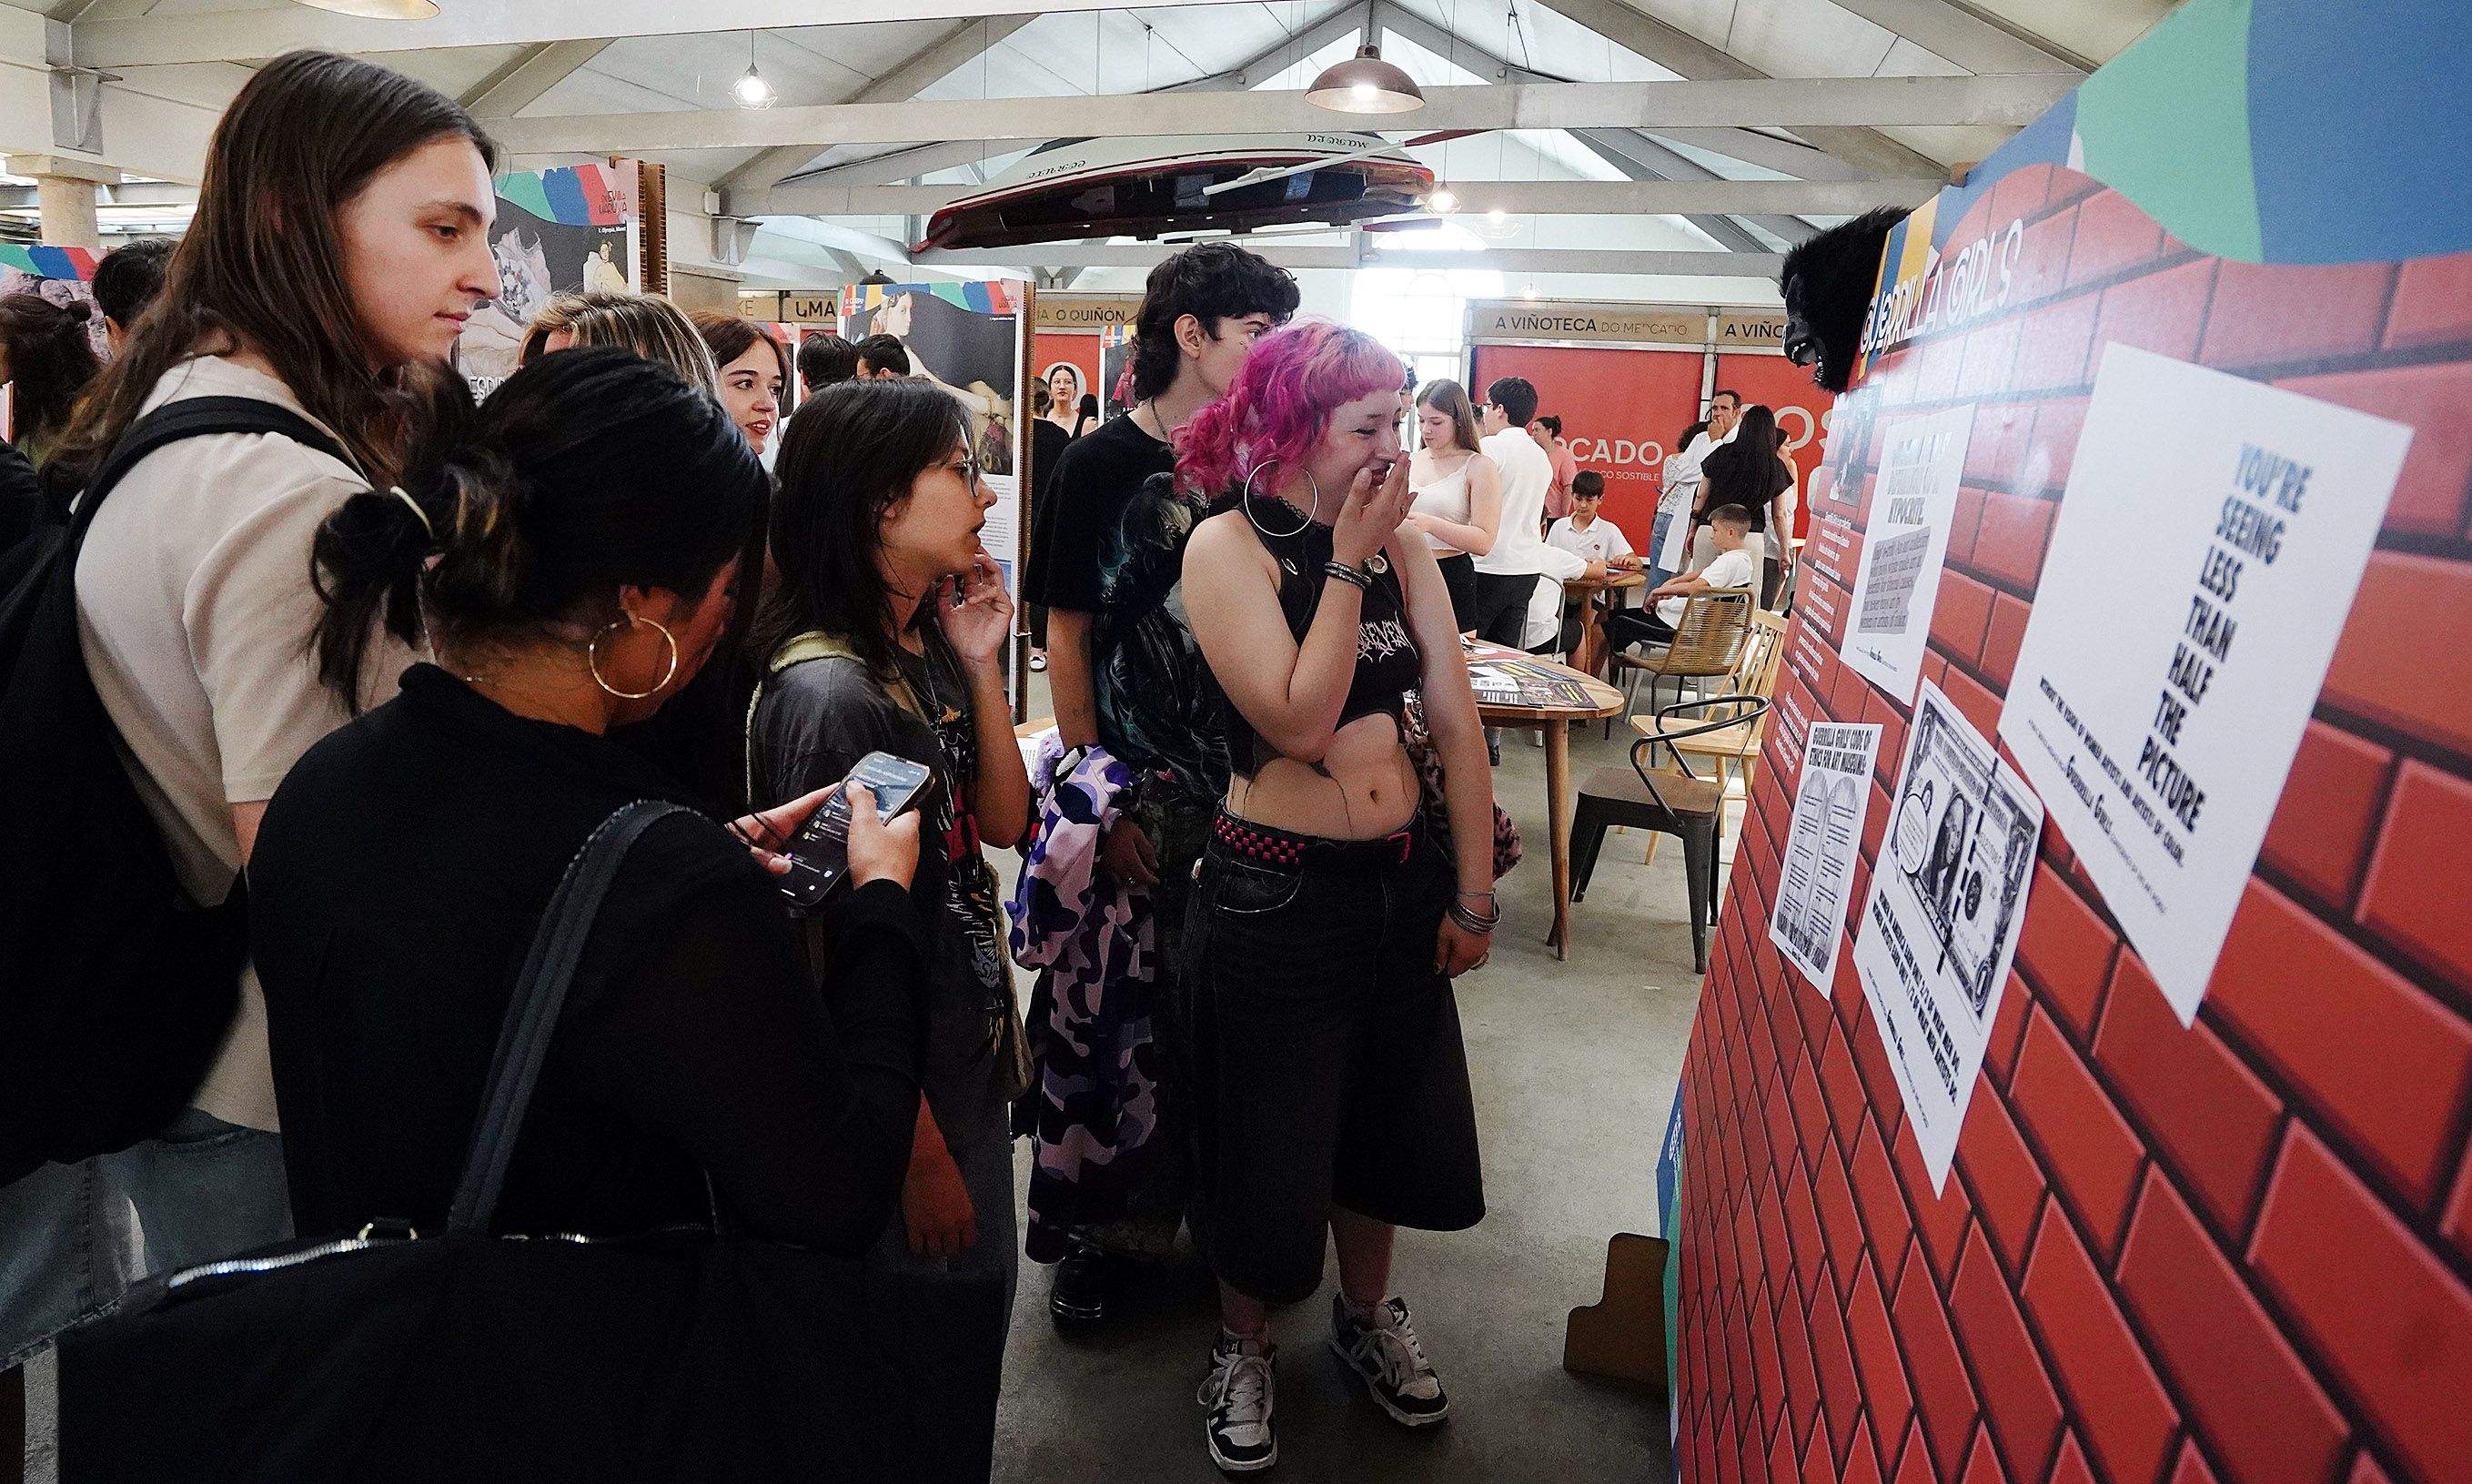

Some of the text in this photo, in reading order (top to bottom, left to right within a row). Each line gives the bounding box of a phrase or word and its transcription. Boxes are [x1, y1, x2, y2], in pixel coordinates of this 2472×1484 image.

[1056, 309, 1067, 321] O
[1070, 308, 1125, 322] QUIÑÓN
[1860, 217, 2023, 356] GUERRILLA GIRLS
[1496, 317, 1507, 329] A
[1511, 313, 1597, 332] VIÑOTECA
[1601, 321, 1620, 333] DO
[1725, 323, 1736, 338] A
[1615, 470, 1660, 482] SOSTIBLE
[2235, 442, 2313, 515] YOU'RE
[2215, 495, 2285, 566] SEEING
[2198, 544, 2244, 603] LESS
[2184, 593, 2238, 663] THAN
[2167, 640, 2214, 706] HALF
[2154, 689, 2187, 747] THE
[2137, 734, 2207, 833] PICTURE
